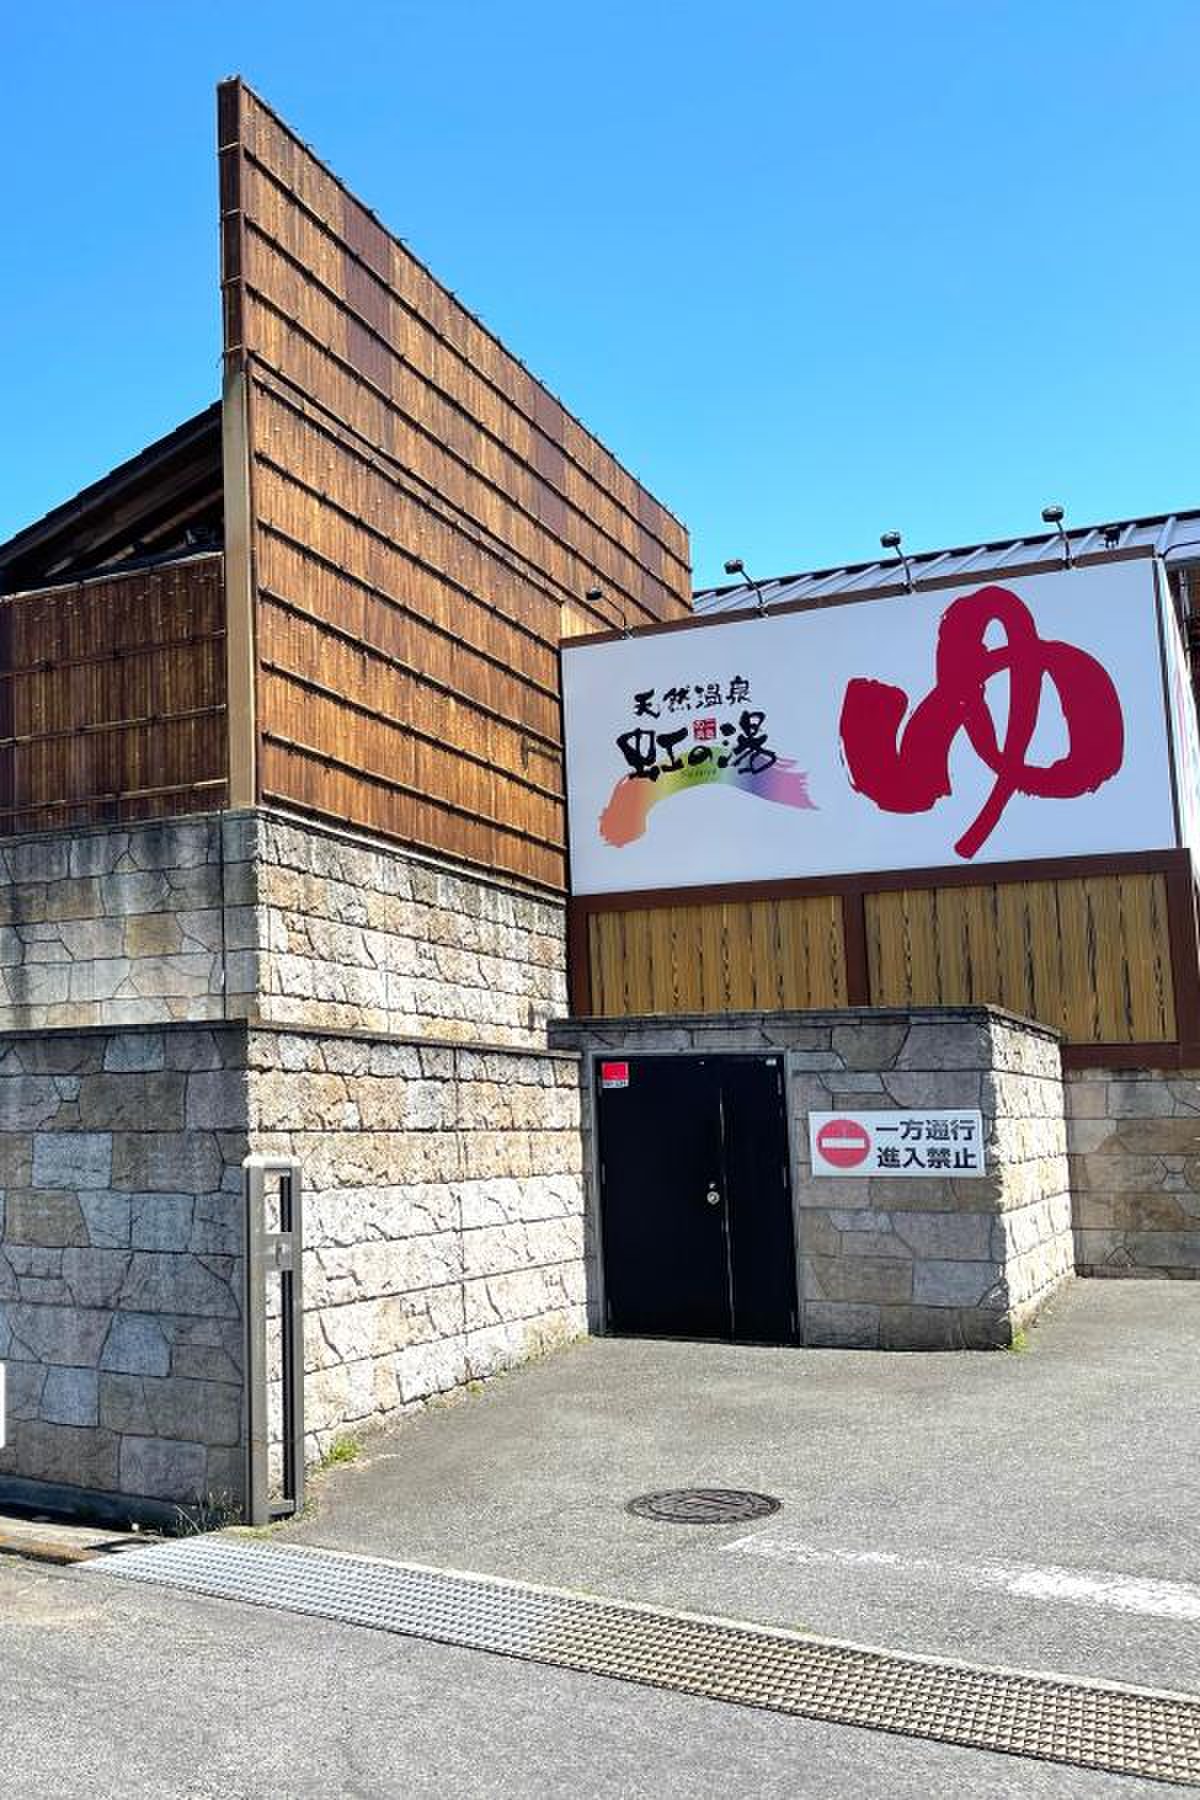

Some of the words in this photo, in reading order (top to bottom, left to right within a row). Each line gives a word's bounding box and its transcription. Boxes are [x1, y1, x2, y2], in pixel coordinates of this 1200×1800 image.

[634, 675, 751, 719] 天然温泉
[840, 586, 1123, 859] ゆ
[616, 710, 777, 782] 虹の湯
[875, 1119, 975, 1141] 一方通行
[877, 1146, 977, 1169] 進入禁止
